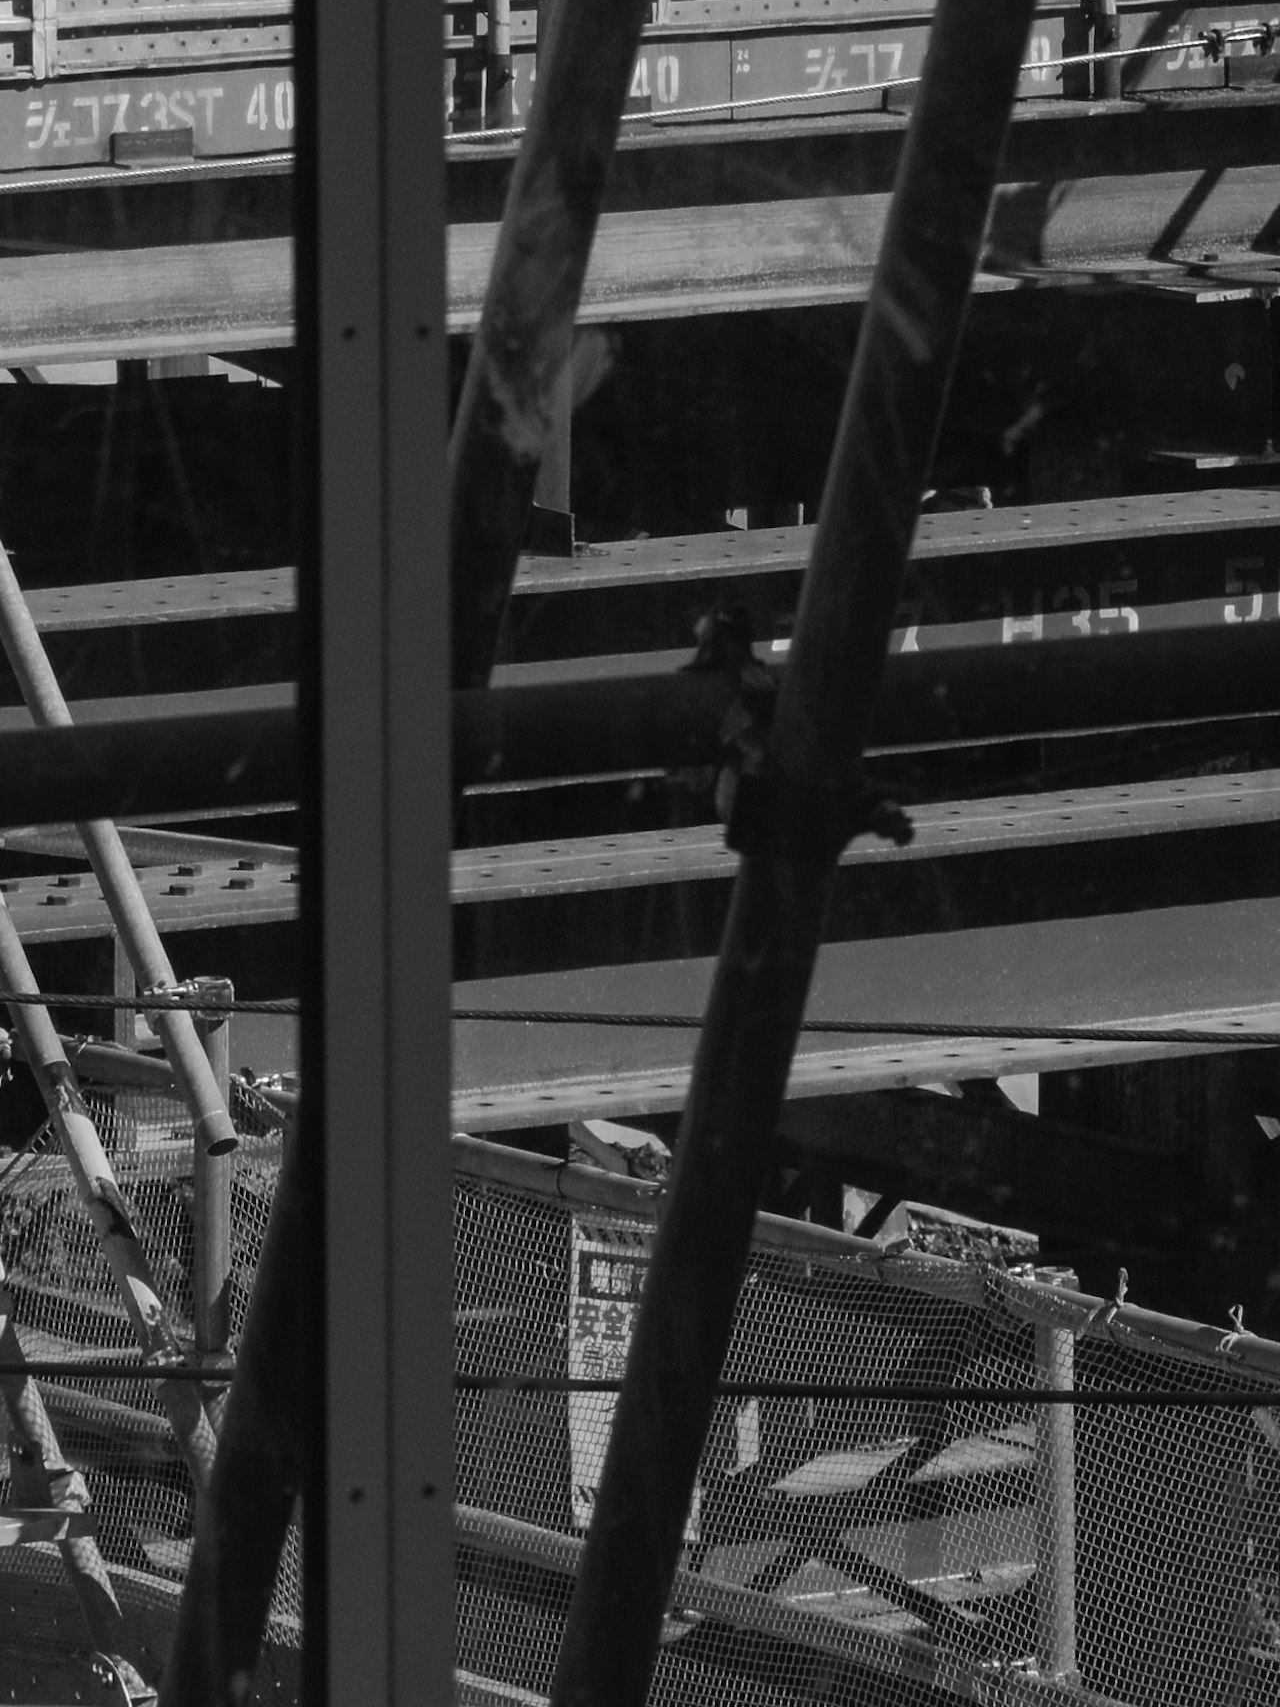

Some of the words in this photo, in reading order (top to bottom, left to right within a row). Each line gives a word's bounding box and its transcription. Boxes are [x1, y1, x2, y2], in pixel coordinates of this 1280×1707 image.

[629, 55, 679, 104] 40
[736, 49, 749, 61] 24
[26, 93, 130, 150] ジェコス
[139, 87, 224, 137] 3ST
[247, 80, 296, 132] 40
